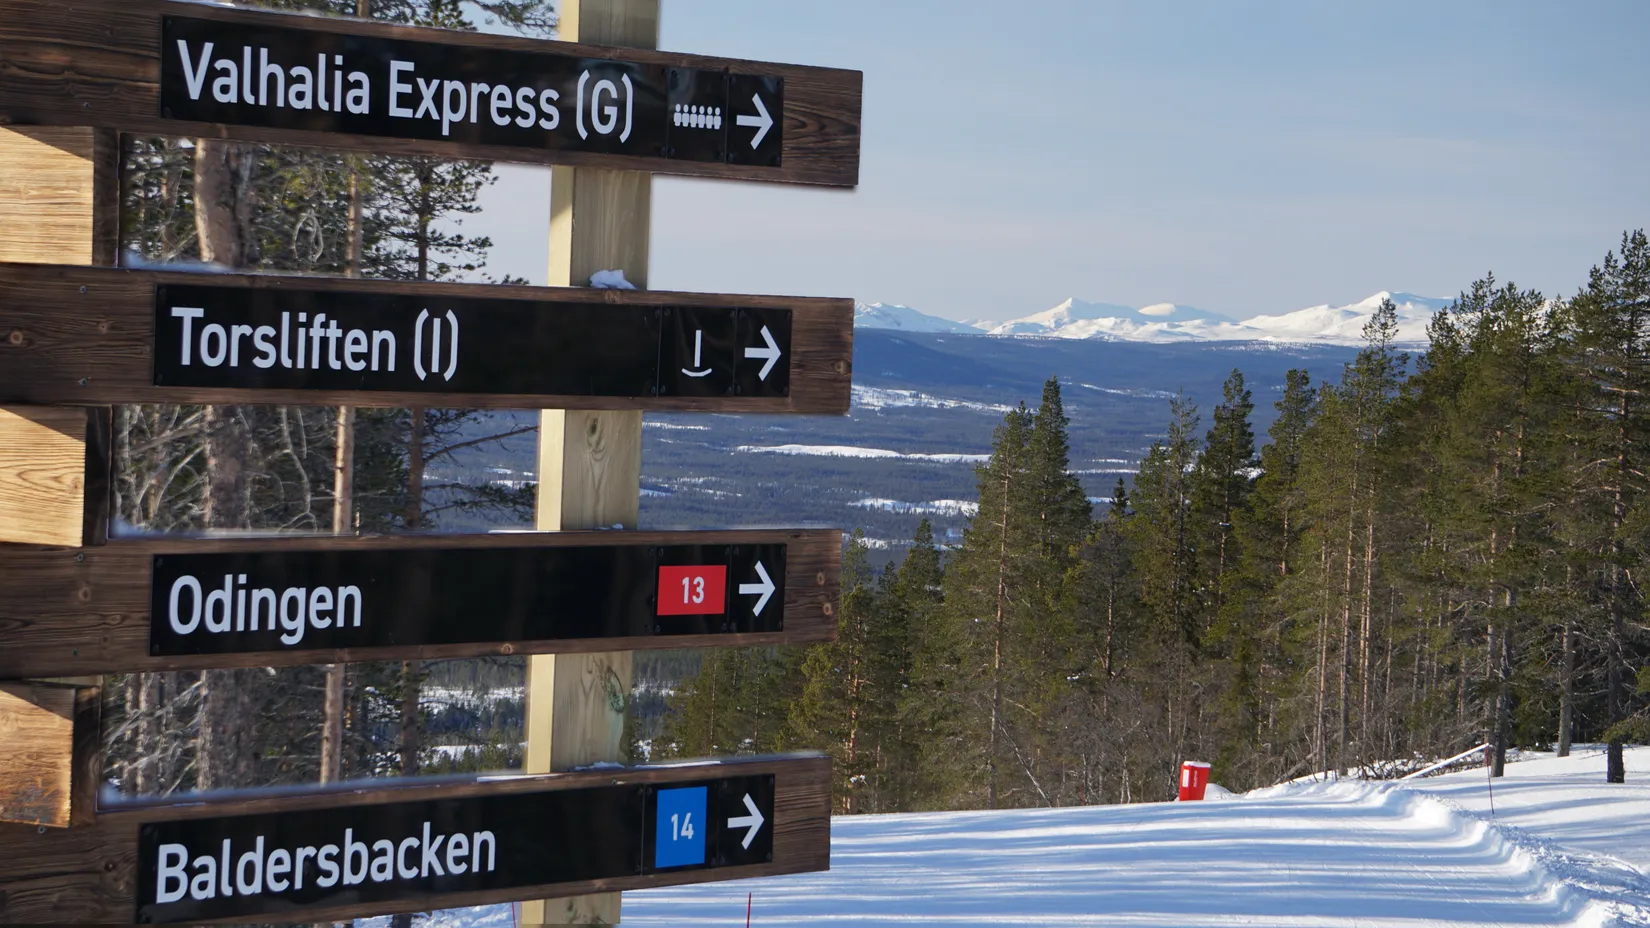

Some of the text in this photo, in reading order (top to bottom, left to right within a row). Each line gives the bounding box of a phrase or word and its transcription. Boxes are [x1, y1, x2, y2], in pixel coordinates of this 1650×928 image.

[177, 39, 633, 143] Valhalia Express (G)
[171, 306, 396, 373] Torsliften
[169, 573, 362, 645] Odingen
[682, 576, 705, 604] 13
[671, 812, 694, 841] 14
[155, 821, 497, 905] Baldersbacken
